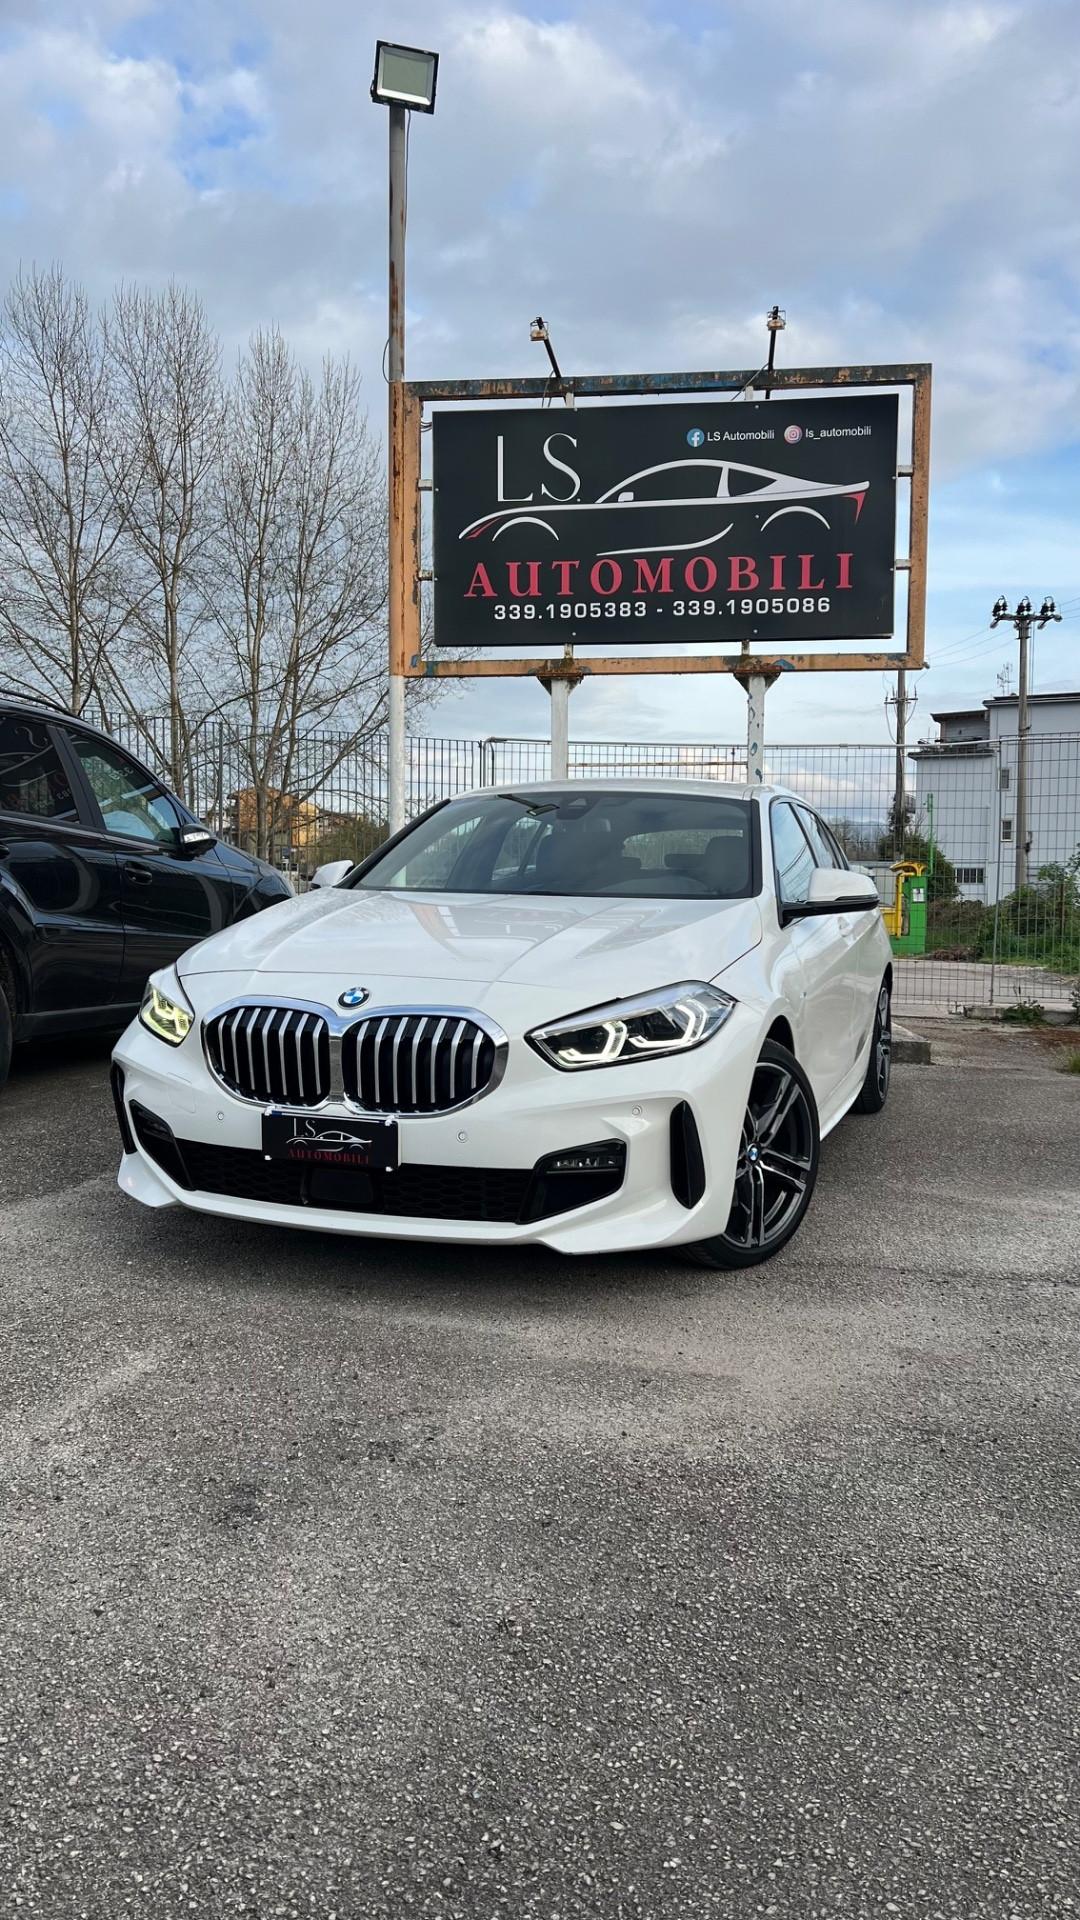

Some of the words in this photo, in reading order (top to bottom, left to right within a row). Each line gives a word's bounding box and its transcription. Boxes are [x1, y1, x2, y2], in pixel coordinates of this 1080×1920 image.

[707, 431, 721, 442] LS
[723, 429, 775, 441] Automobili
[805, 425, 872, 440] ls_automobili
[464, 553, 854, 597] AUTOMOBILI
[494, 601, 647, 620] 339.1905383
[672, 598, 831, 616] 339.1905086
